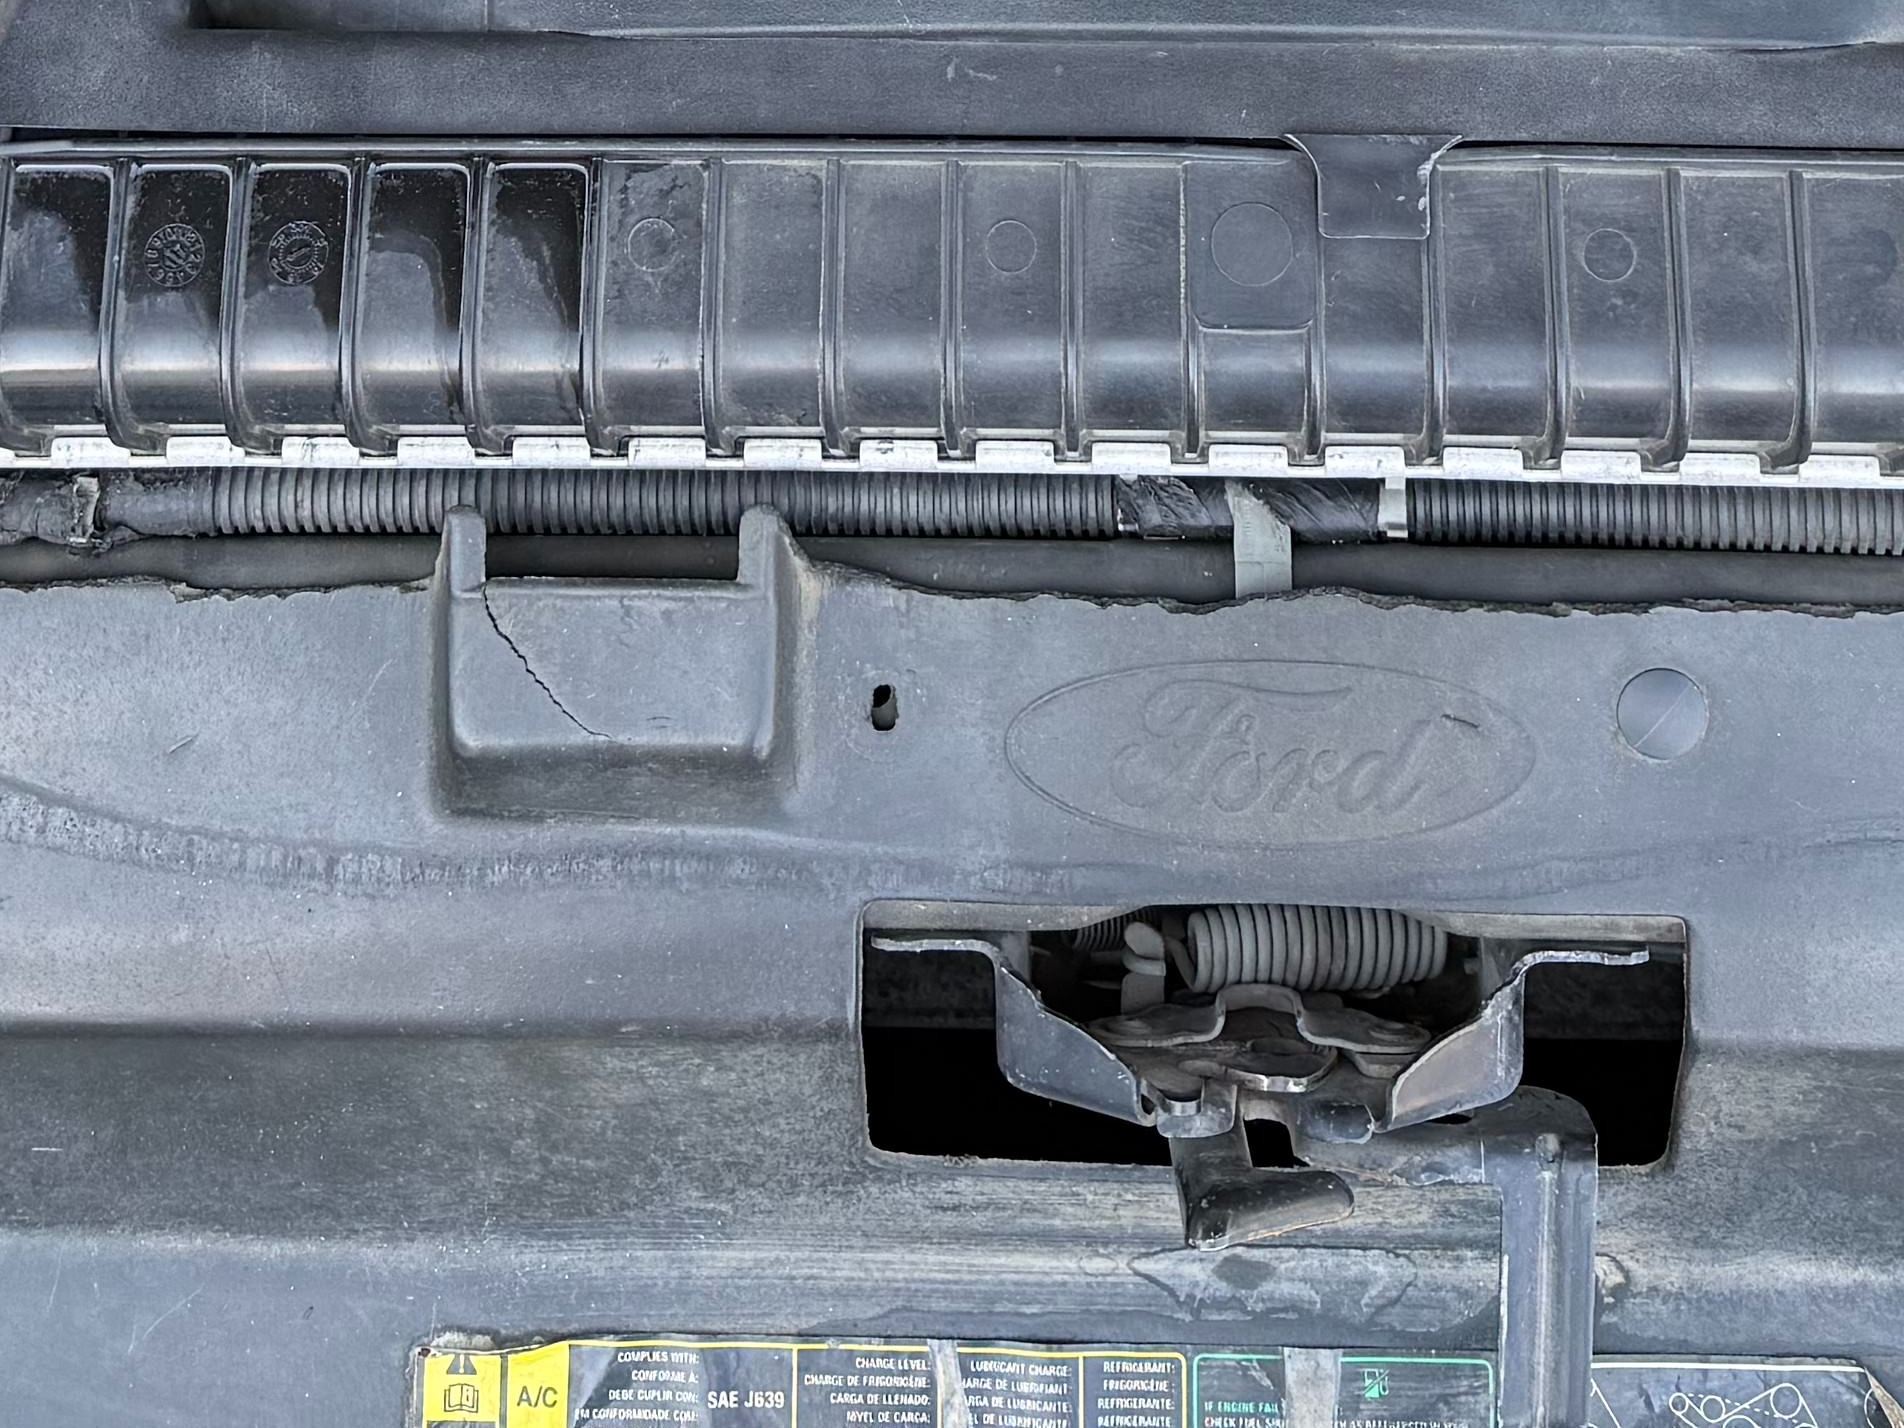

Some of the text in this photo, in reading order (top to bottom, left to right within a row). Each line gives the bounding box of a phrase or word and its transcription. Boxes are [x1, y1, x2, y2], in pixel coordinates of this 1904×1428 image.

[1110, 678, 1437, 814] Ford
[618, 1351, 668, 1364] COMPLIES
[856, 1357, 895, 1370] CHARGE
[517, 1386, 558, 1408] A/C
[707, 1391, 785, 1409] SAE J639
